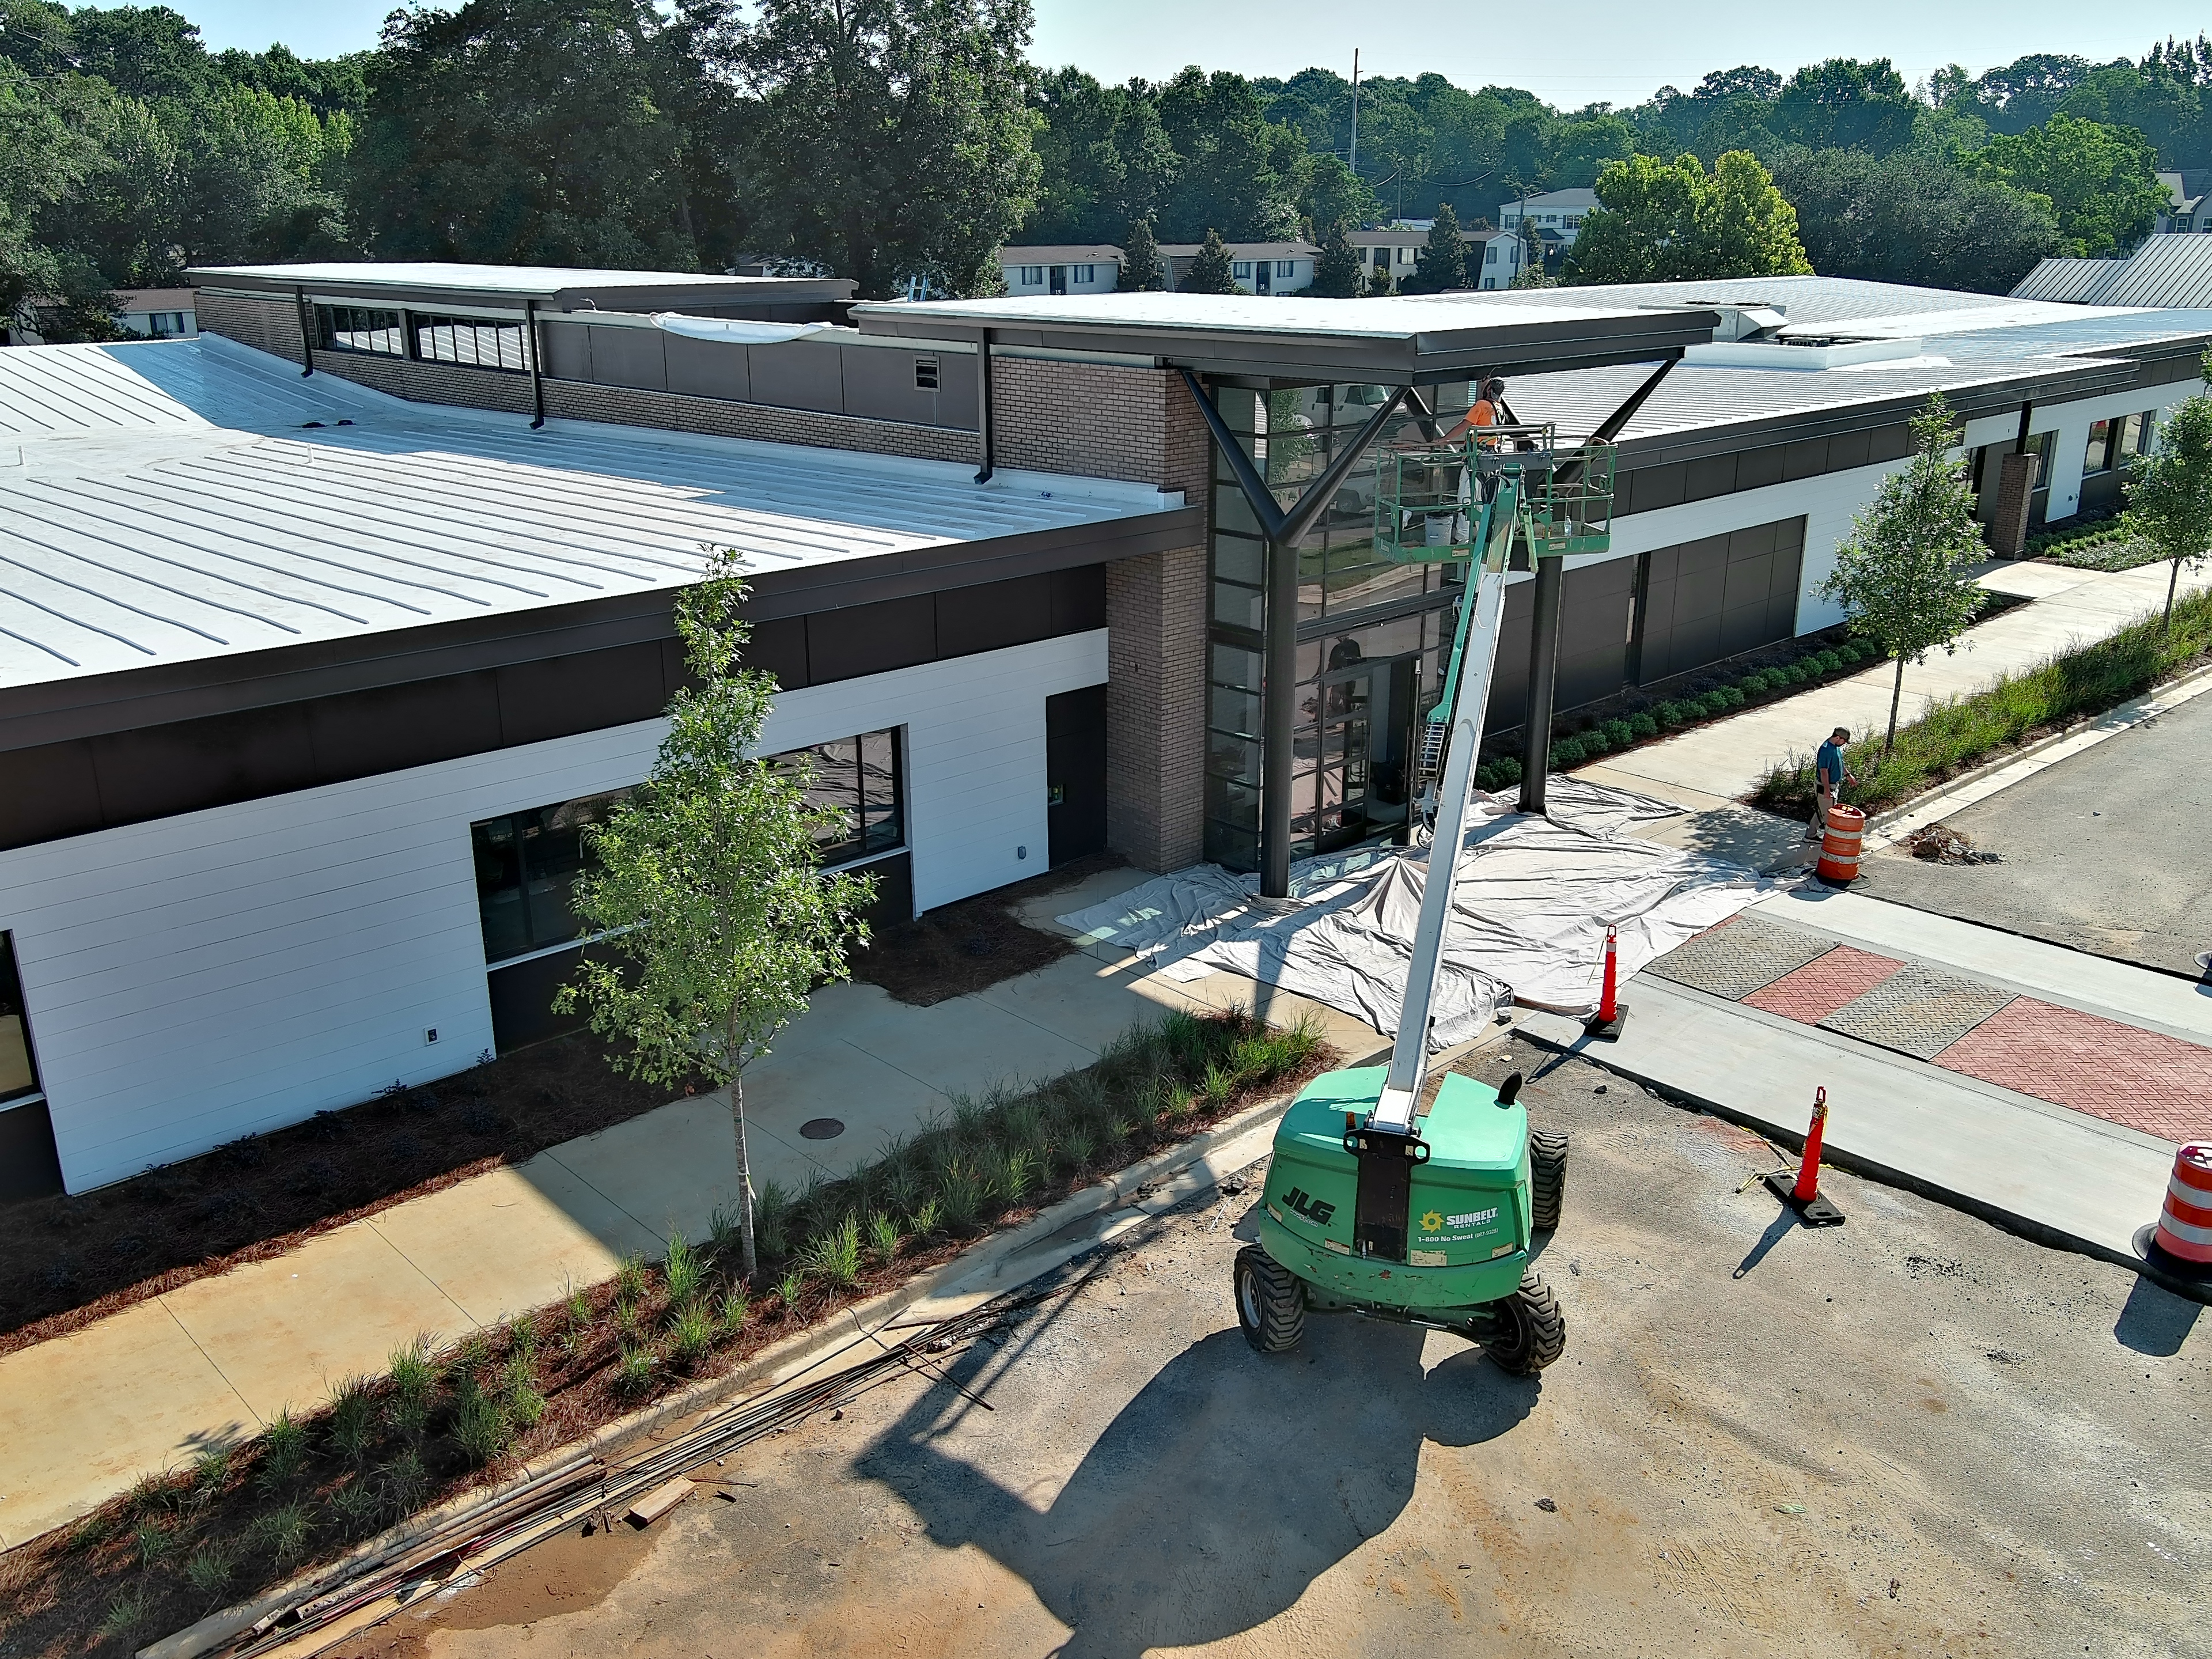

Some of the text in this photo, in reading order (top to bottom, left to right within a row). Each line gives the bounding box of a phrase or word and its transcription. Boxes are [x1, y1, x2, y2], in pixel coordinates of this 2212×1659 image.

[1282, 1186, 1336, 1225] JLG
[1290, 1208, 1318, 1228] jlg.com
[1446, 1207, 1498, 1225] SUNBELT
[1454, 1219, 1491, 1229] RENTALS
[1452, 1233, 1473, 1241] Sweat
